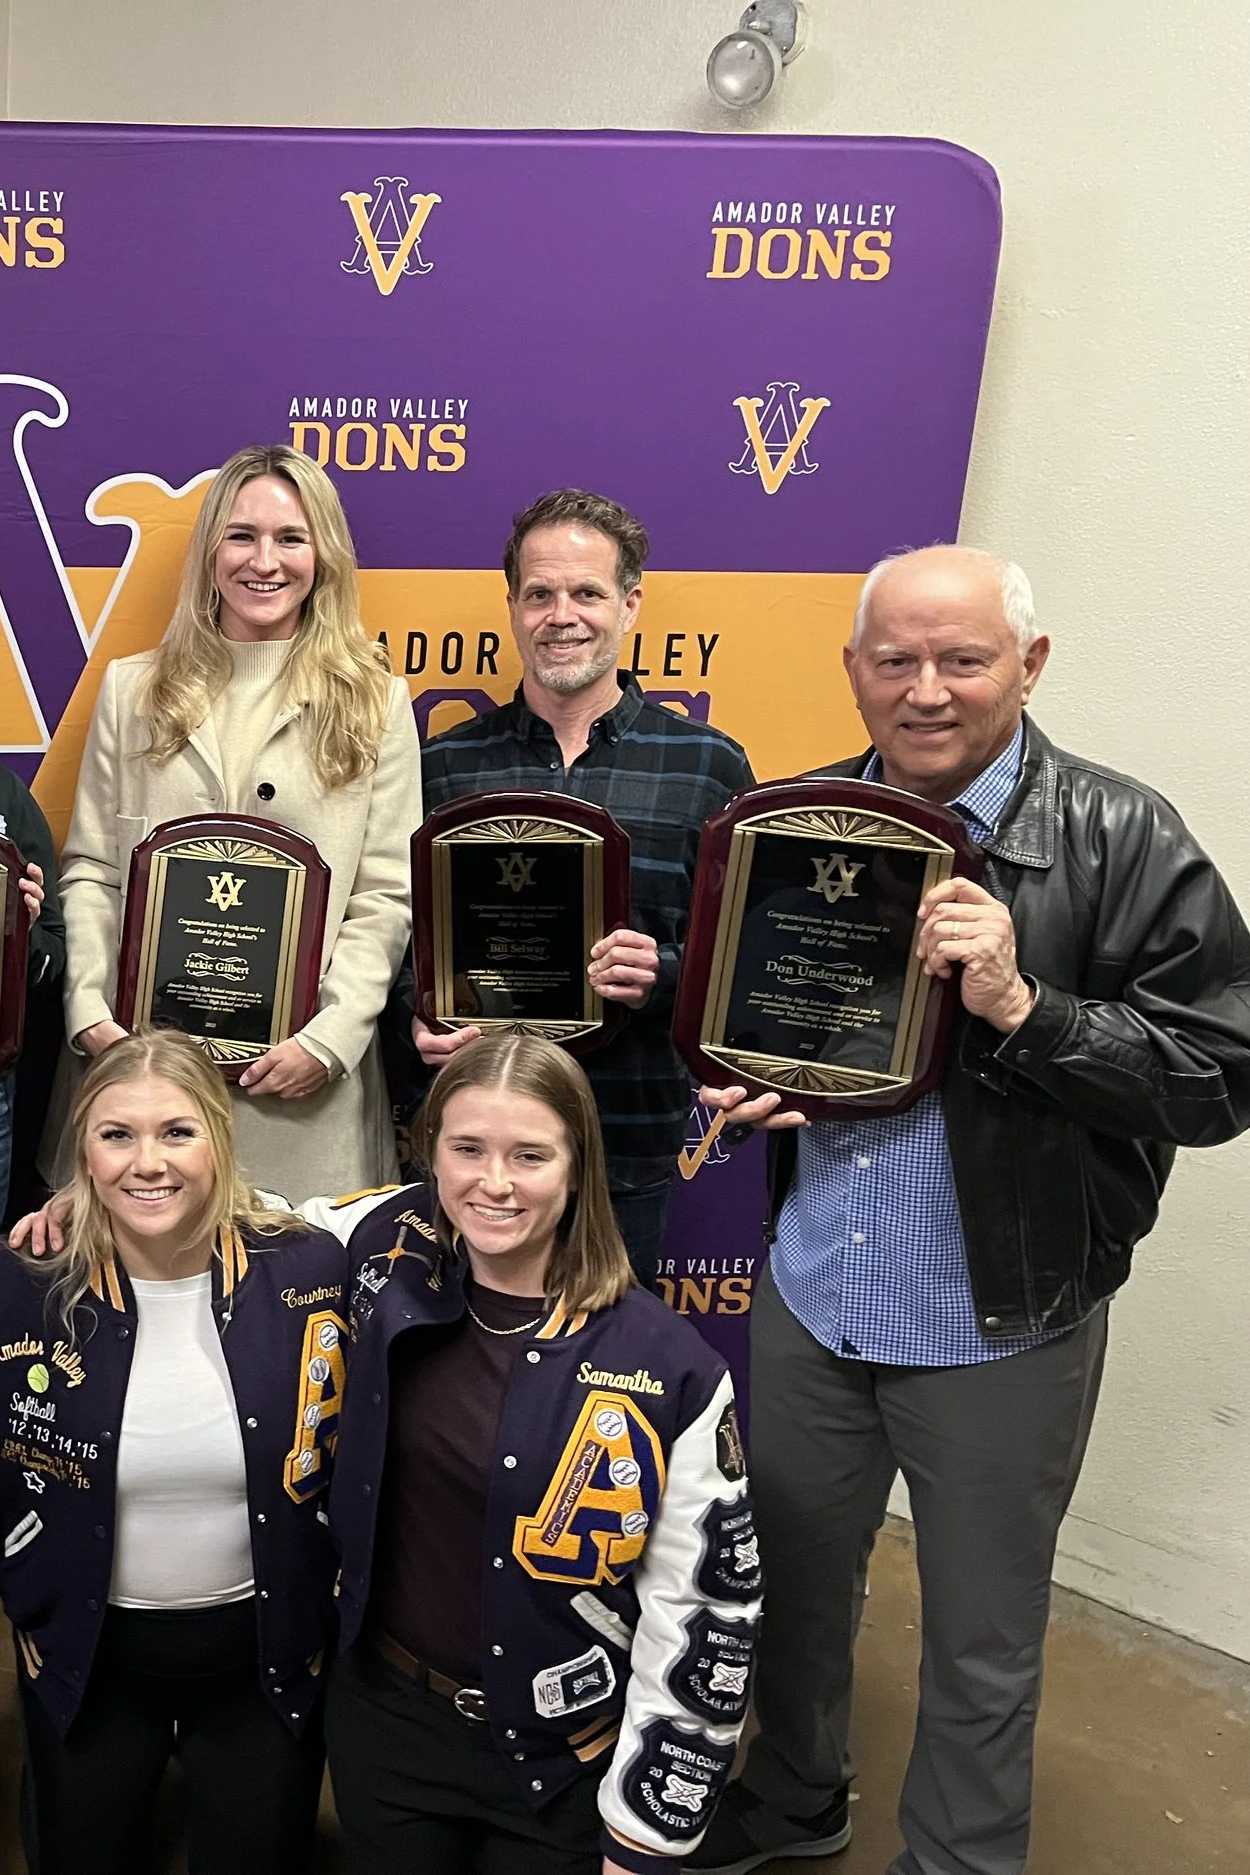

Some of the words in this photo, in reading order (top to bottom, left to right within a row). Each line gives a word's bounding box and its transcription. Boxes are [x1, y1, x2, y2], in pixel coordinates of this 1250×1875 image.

[712, 201, 803, 224] AMADOR
[815, 203, 896, 226] VALLEY
[706, 227, 892, 281] DONS
[288, 397, 378, 418] AMADOR
[389, 398, 469, 419] VALLEY
[288, 421, 466, 472] DONS
[489, 943, 509, 953] Bill
[510, 943, 546, 955] Selway
[184, 958, 214, 971] Jackie
[215, 962, 250, 975] Gilbert
[765, 960, 794, 975] Don
[797, 965, 874, 986] Underwood
[687, 1257, 755, 1275] VALLEY
[280, 1284, 342, 1309] Courtney
[656, 1277, 753, 1316] NS
[50, 1340, 87, 1389] Valley
[576, 1361, 665, 1396] Samantha
[10, 1391, 56, 1424] Softball
[544, 1444, 597, 1545] ACADEMICS
[707, 1630, 740, 1648] NORTH
[697, 1657, 711, 1669] 20
[660, 1740, 696, 1764] NORTH
[649, 1765, 663, 1779] 20
[640, 1781, 691, 1828] SCHOLASTIC
